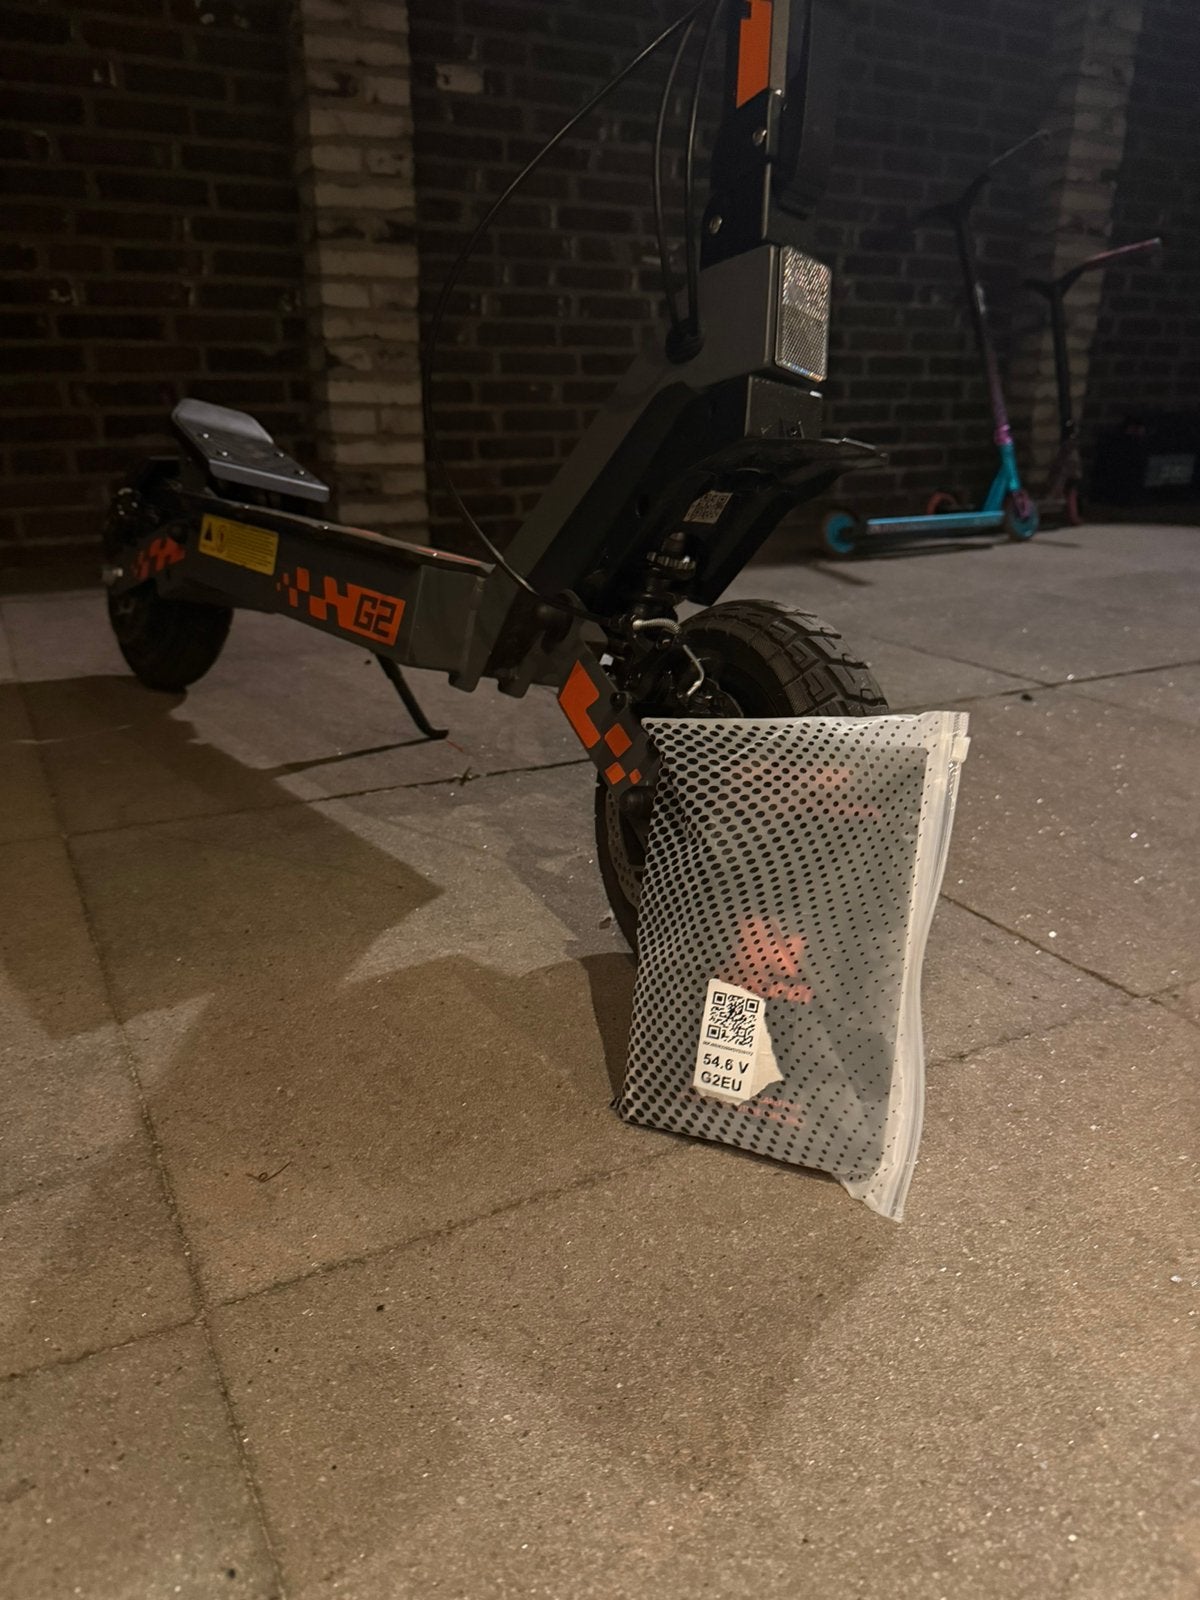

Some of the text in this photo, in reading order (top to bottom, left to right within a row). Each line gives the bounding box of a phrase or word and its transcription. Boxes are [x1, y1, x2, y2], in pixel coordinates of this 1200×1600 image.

[353, 594, 398, 638] G2
[703, 1053, 750, 1074] 54.6 V
[701, 1071, 742, 1092] G2EU
